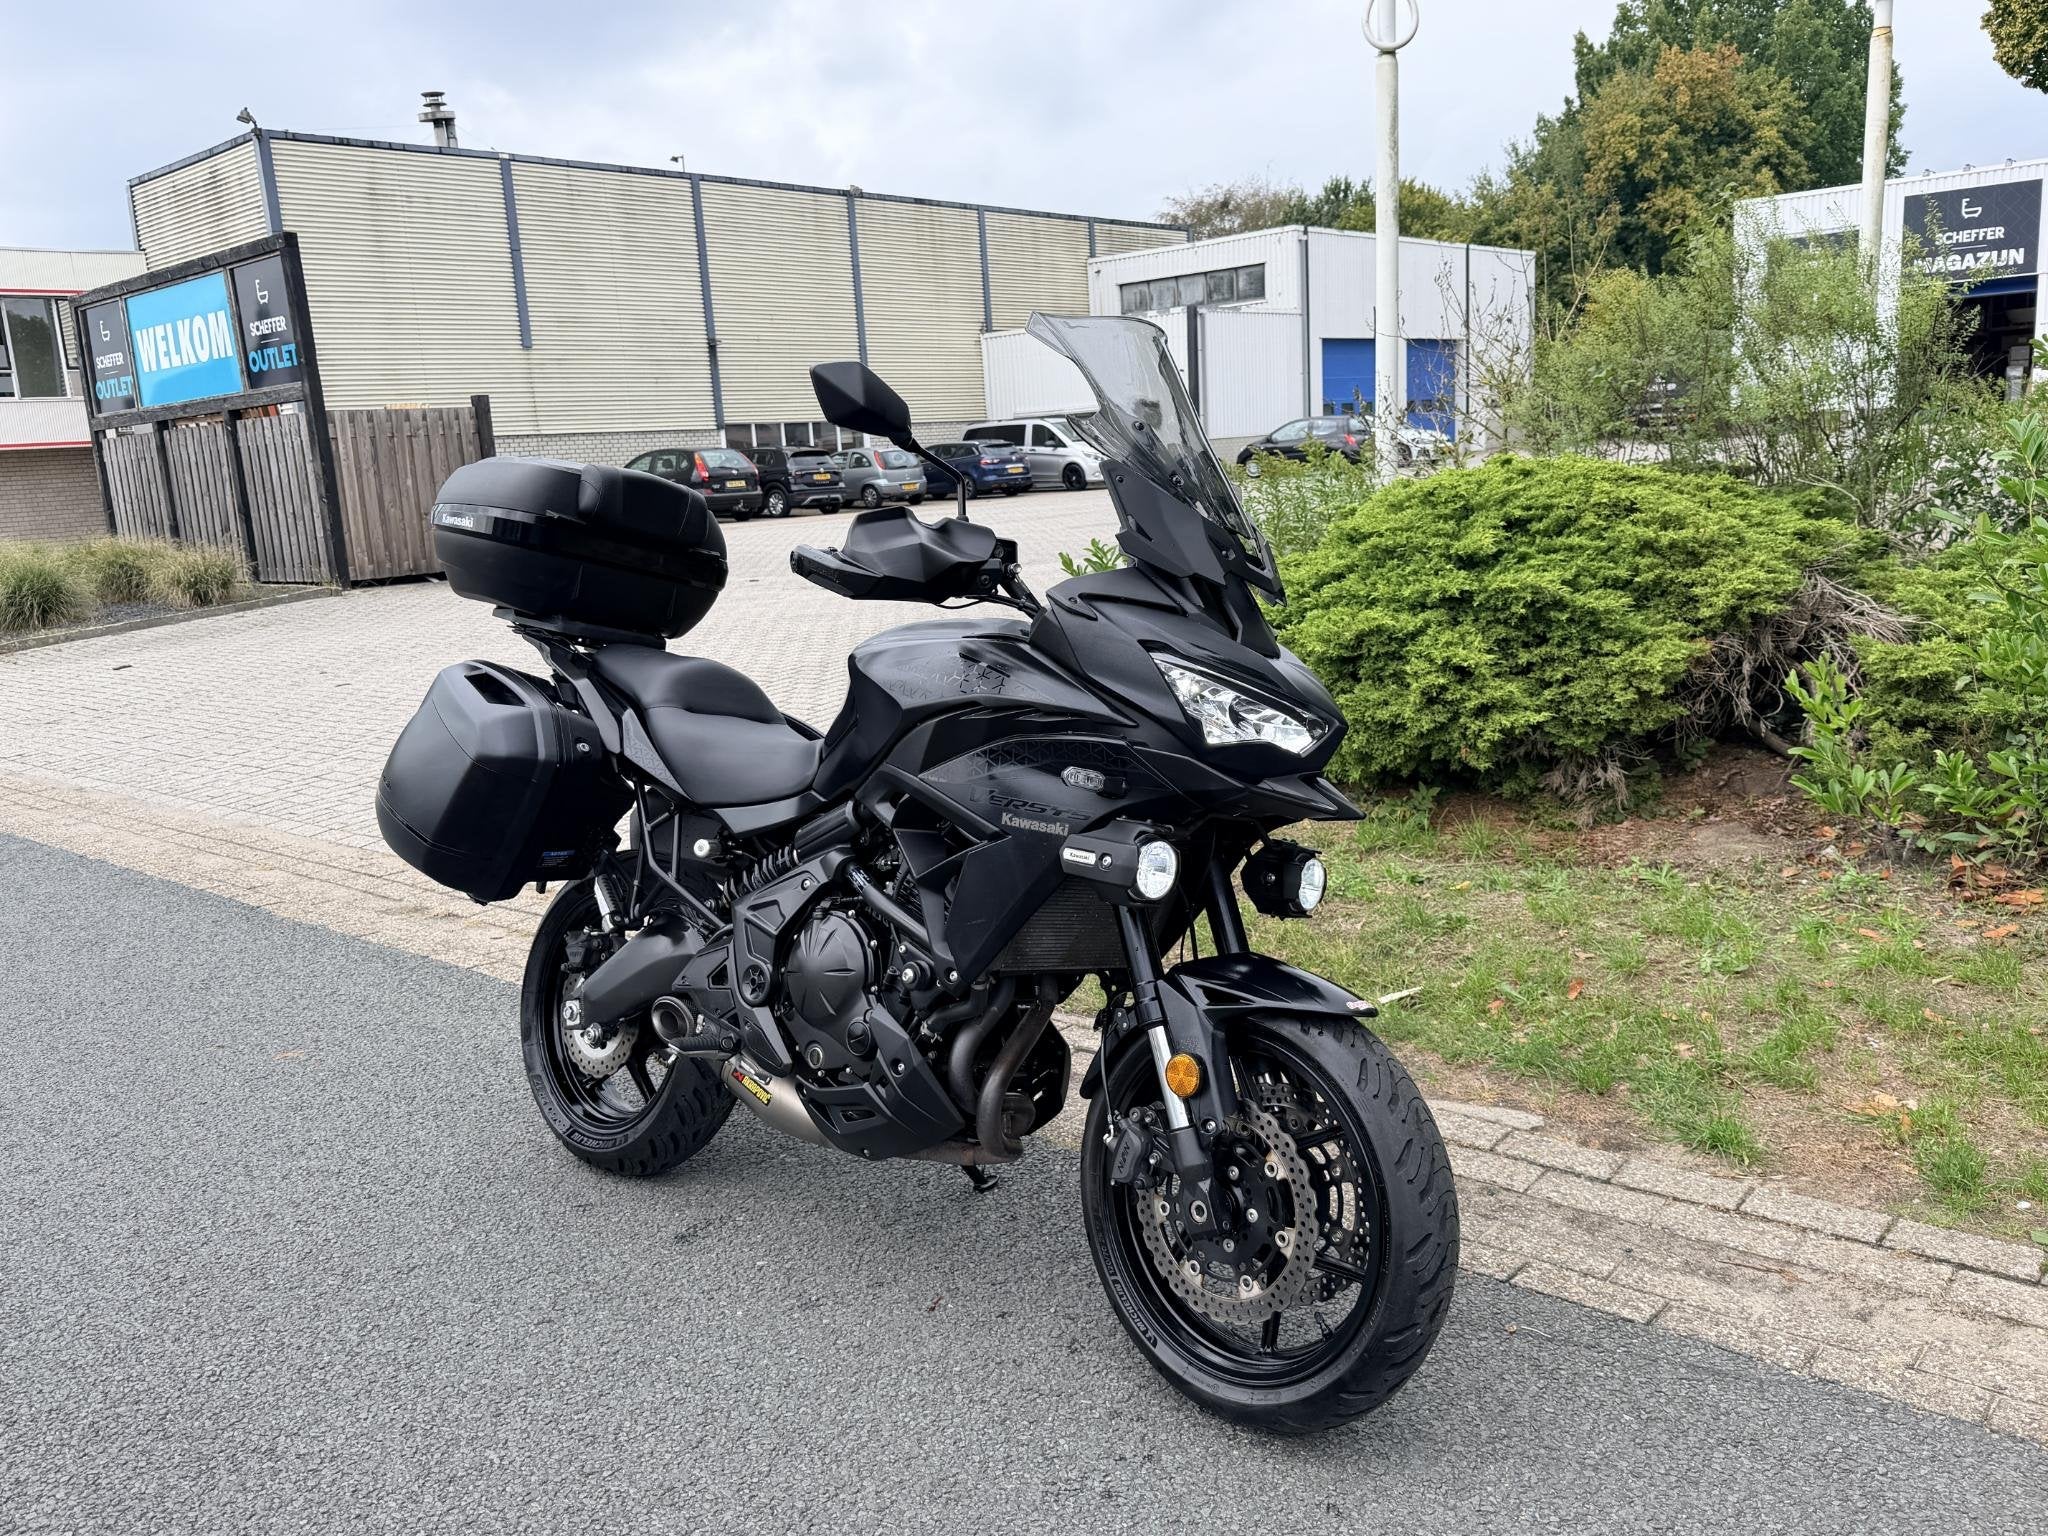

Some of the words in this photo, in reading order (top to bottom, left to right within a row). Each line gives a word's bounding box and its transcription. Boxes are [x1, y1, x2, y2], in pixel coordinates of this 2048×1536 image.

[1935, 226, 2005, 245] SCHEFFER
[249, 315, 287, 337] SCHEFFER
[135, 309, 233, 373] WELKOM
[96, 352, 124, 369] SCHEFFER
[249, 344, 297, 373] OUTLET
[96, 376, 132, 399] OUTLET
[442, 513, 474, 528] Kawasaki
[1001, 812, 1070, 837] Kawasaki
[572, 1132, 615, 1147] MICHELIN
[1114, 1283, 1147, 1331] MICHELIN
